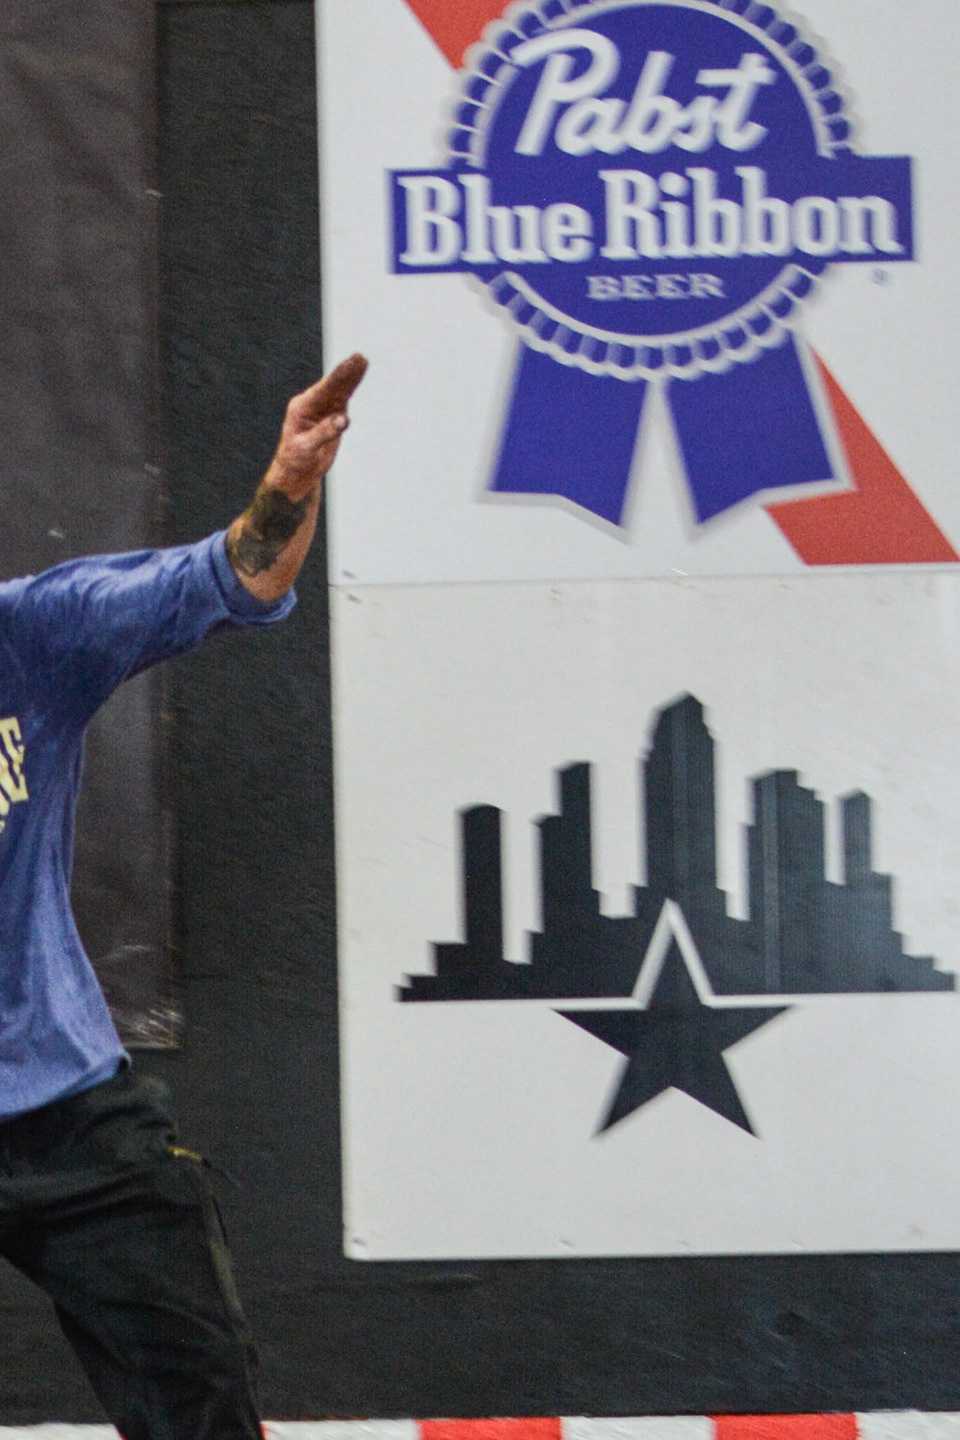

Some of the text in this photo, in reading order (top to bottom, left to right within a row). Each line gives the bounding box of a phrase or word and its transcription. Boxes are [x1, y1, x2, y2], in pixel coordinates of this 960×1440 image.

[509, 27, 778, 156] Pabst
[396, 165, 906, 266] Blue Ribbon
[586, 273, 727, 300] BEER
